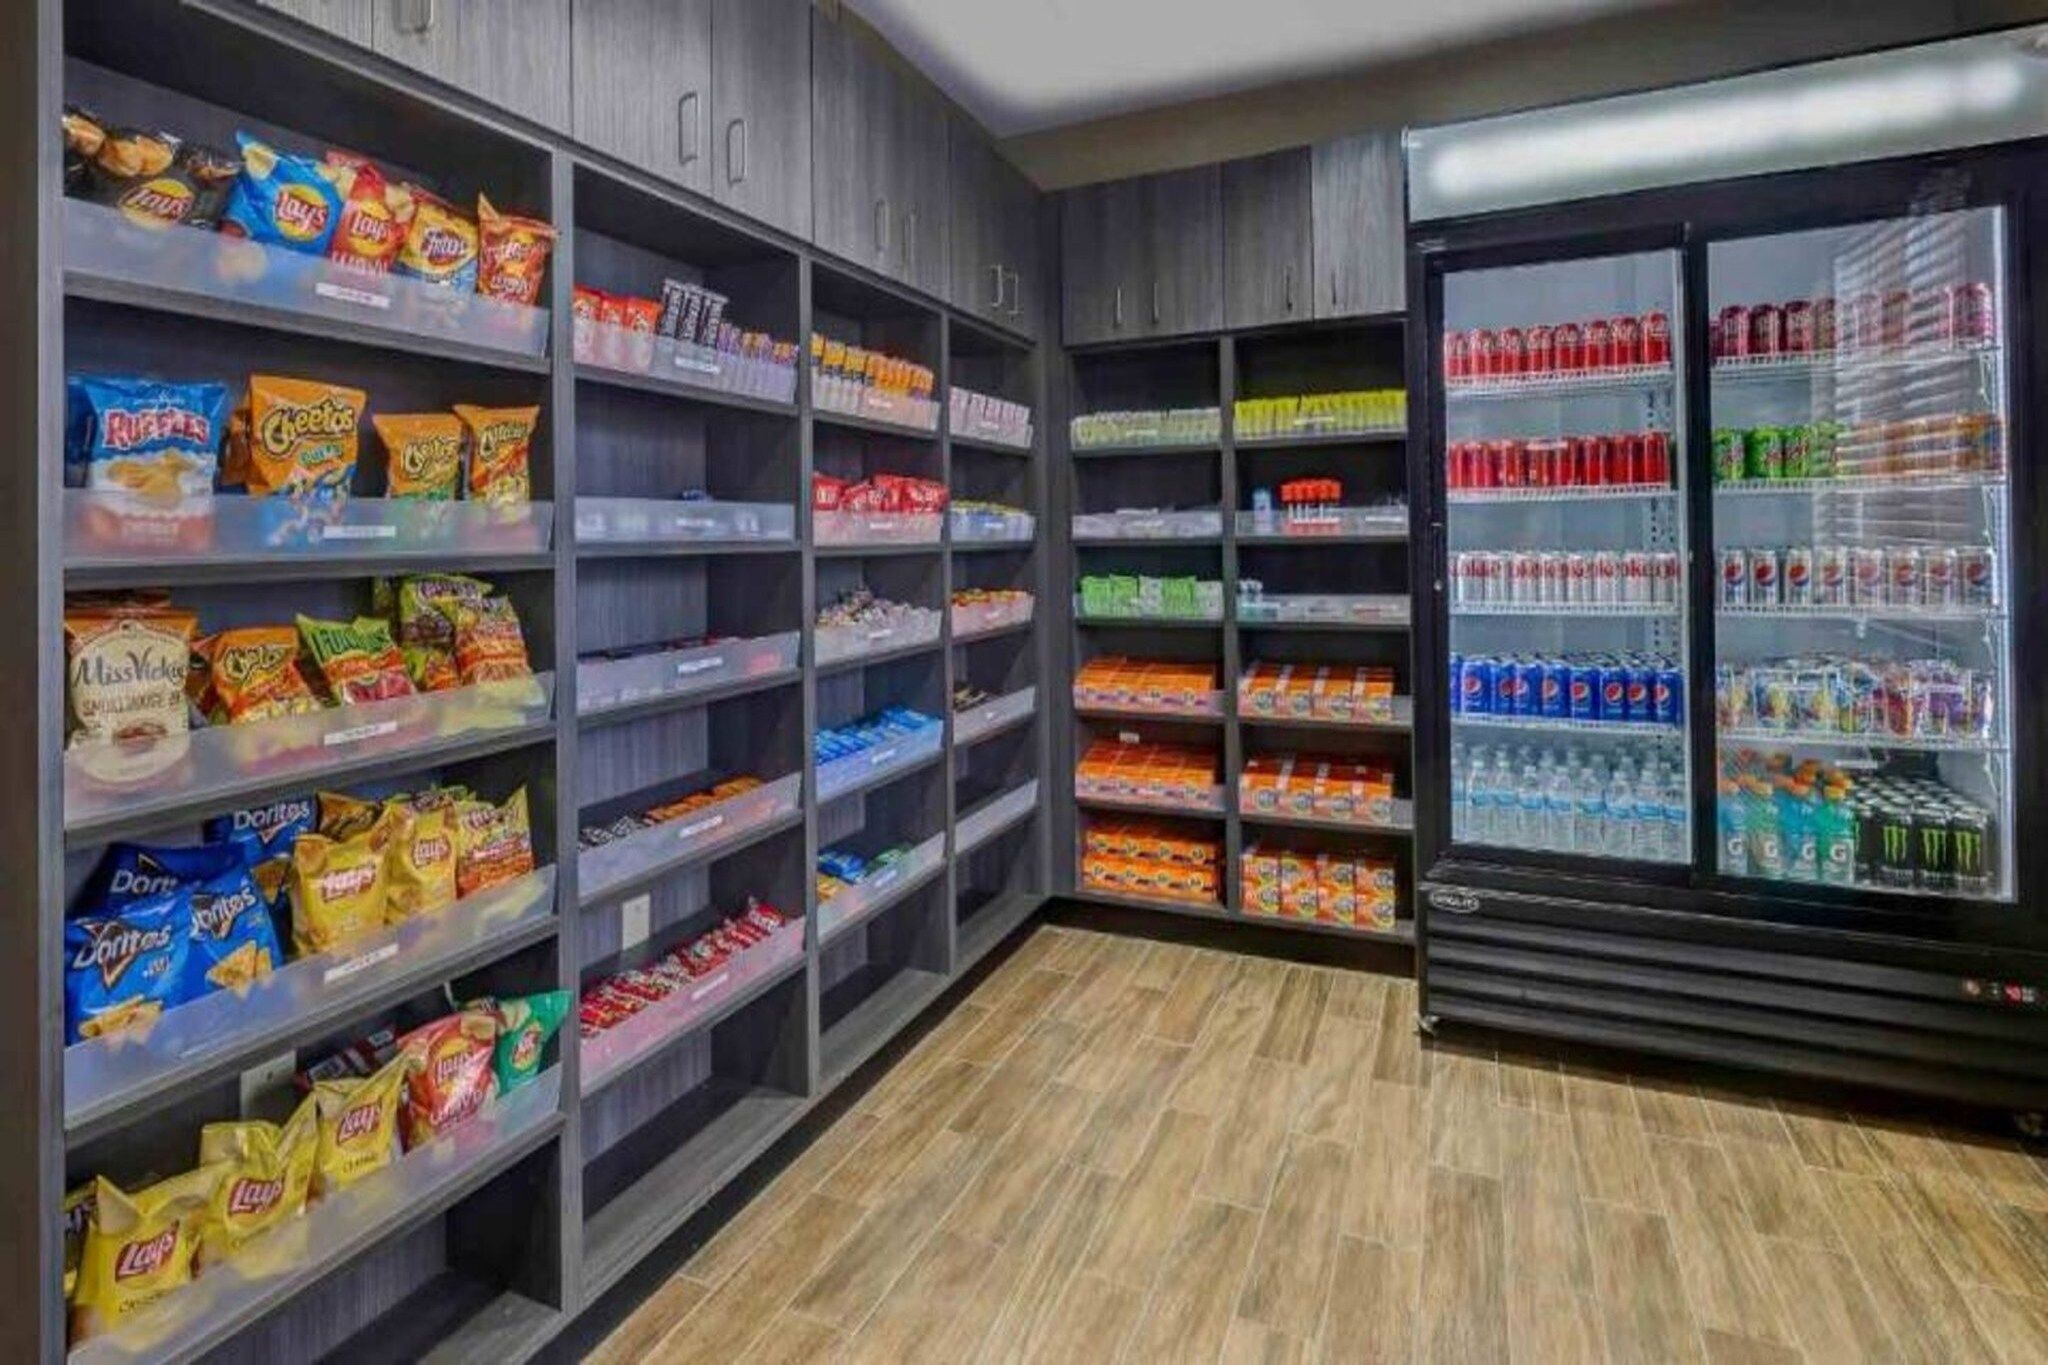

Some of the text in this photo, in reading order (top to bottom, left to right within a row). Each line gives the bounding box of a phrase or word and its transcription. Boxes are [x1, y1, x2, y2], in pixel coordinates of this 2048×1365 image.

[276, 191, 328, 231] Lay's
[262, 399, 355, 457] Cheetos
[73, 655, 132, 688] Miss
[235, 801, 310, 830] Doritos
[73, 923, 173, 969] Doritos
[116, 1231, 178, 1279] Lay's
